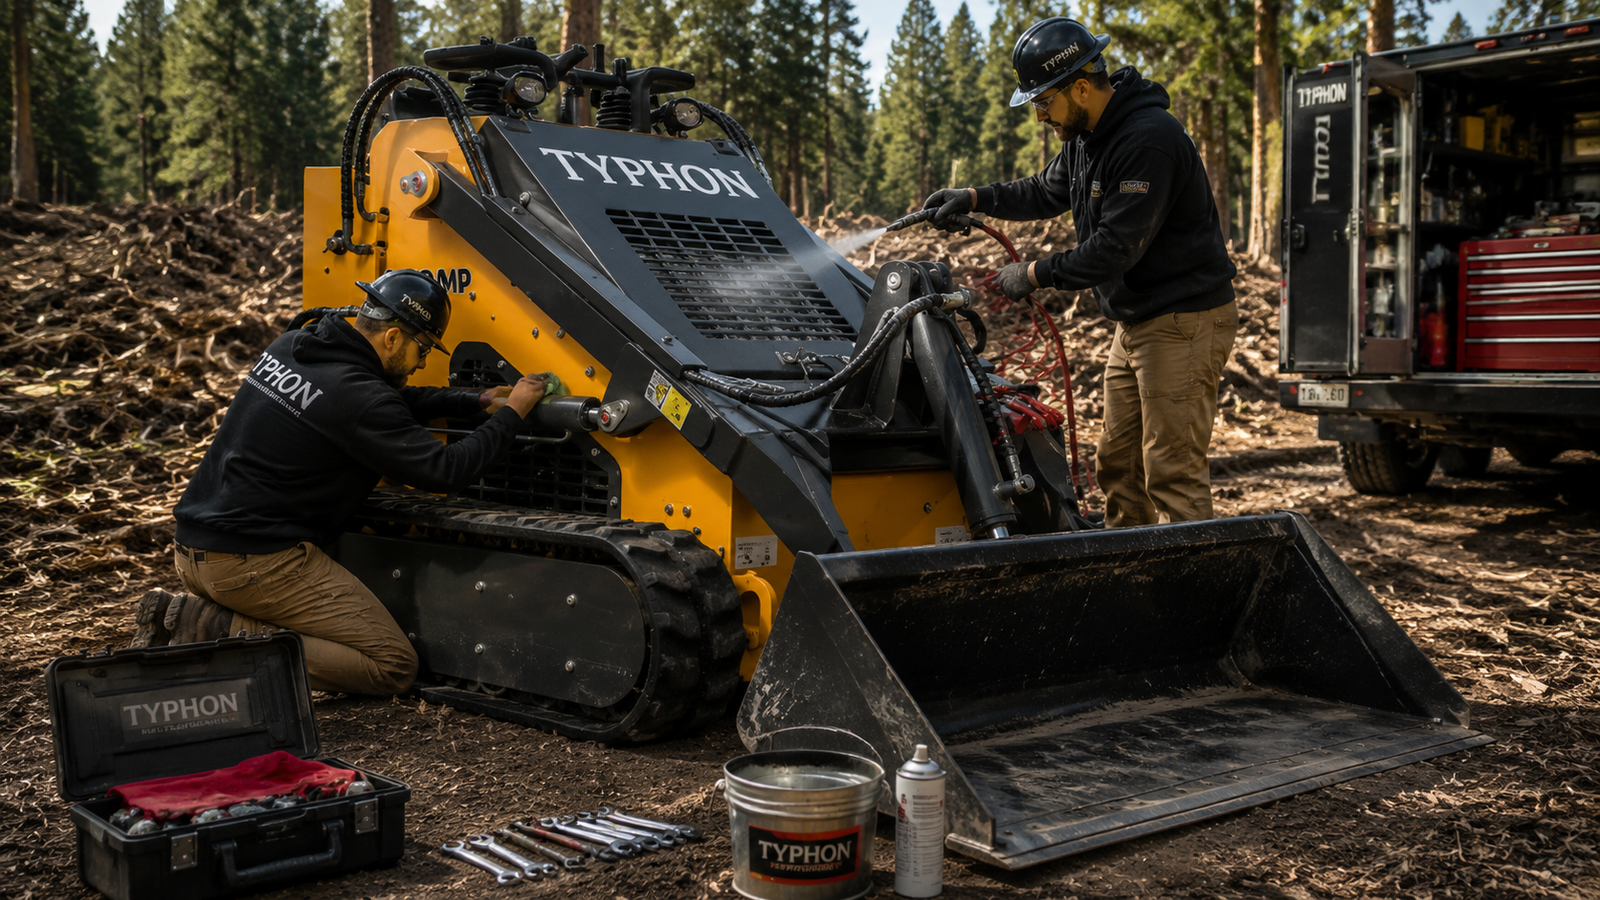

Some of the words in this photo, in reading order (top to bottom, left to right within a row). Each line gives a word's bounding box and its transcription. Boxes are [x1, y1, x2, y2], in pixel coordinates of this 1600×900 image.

[538, 147, 761, 200] TYPHON
[123, 692, 238, 726] TYPHON
[758, 840, 852, 864] TYPHON
